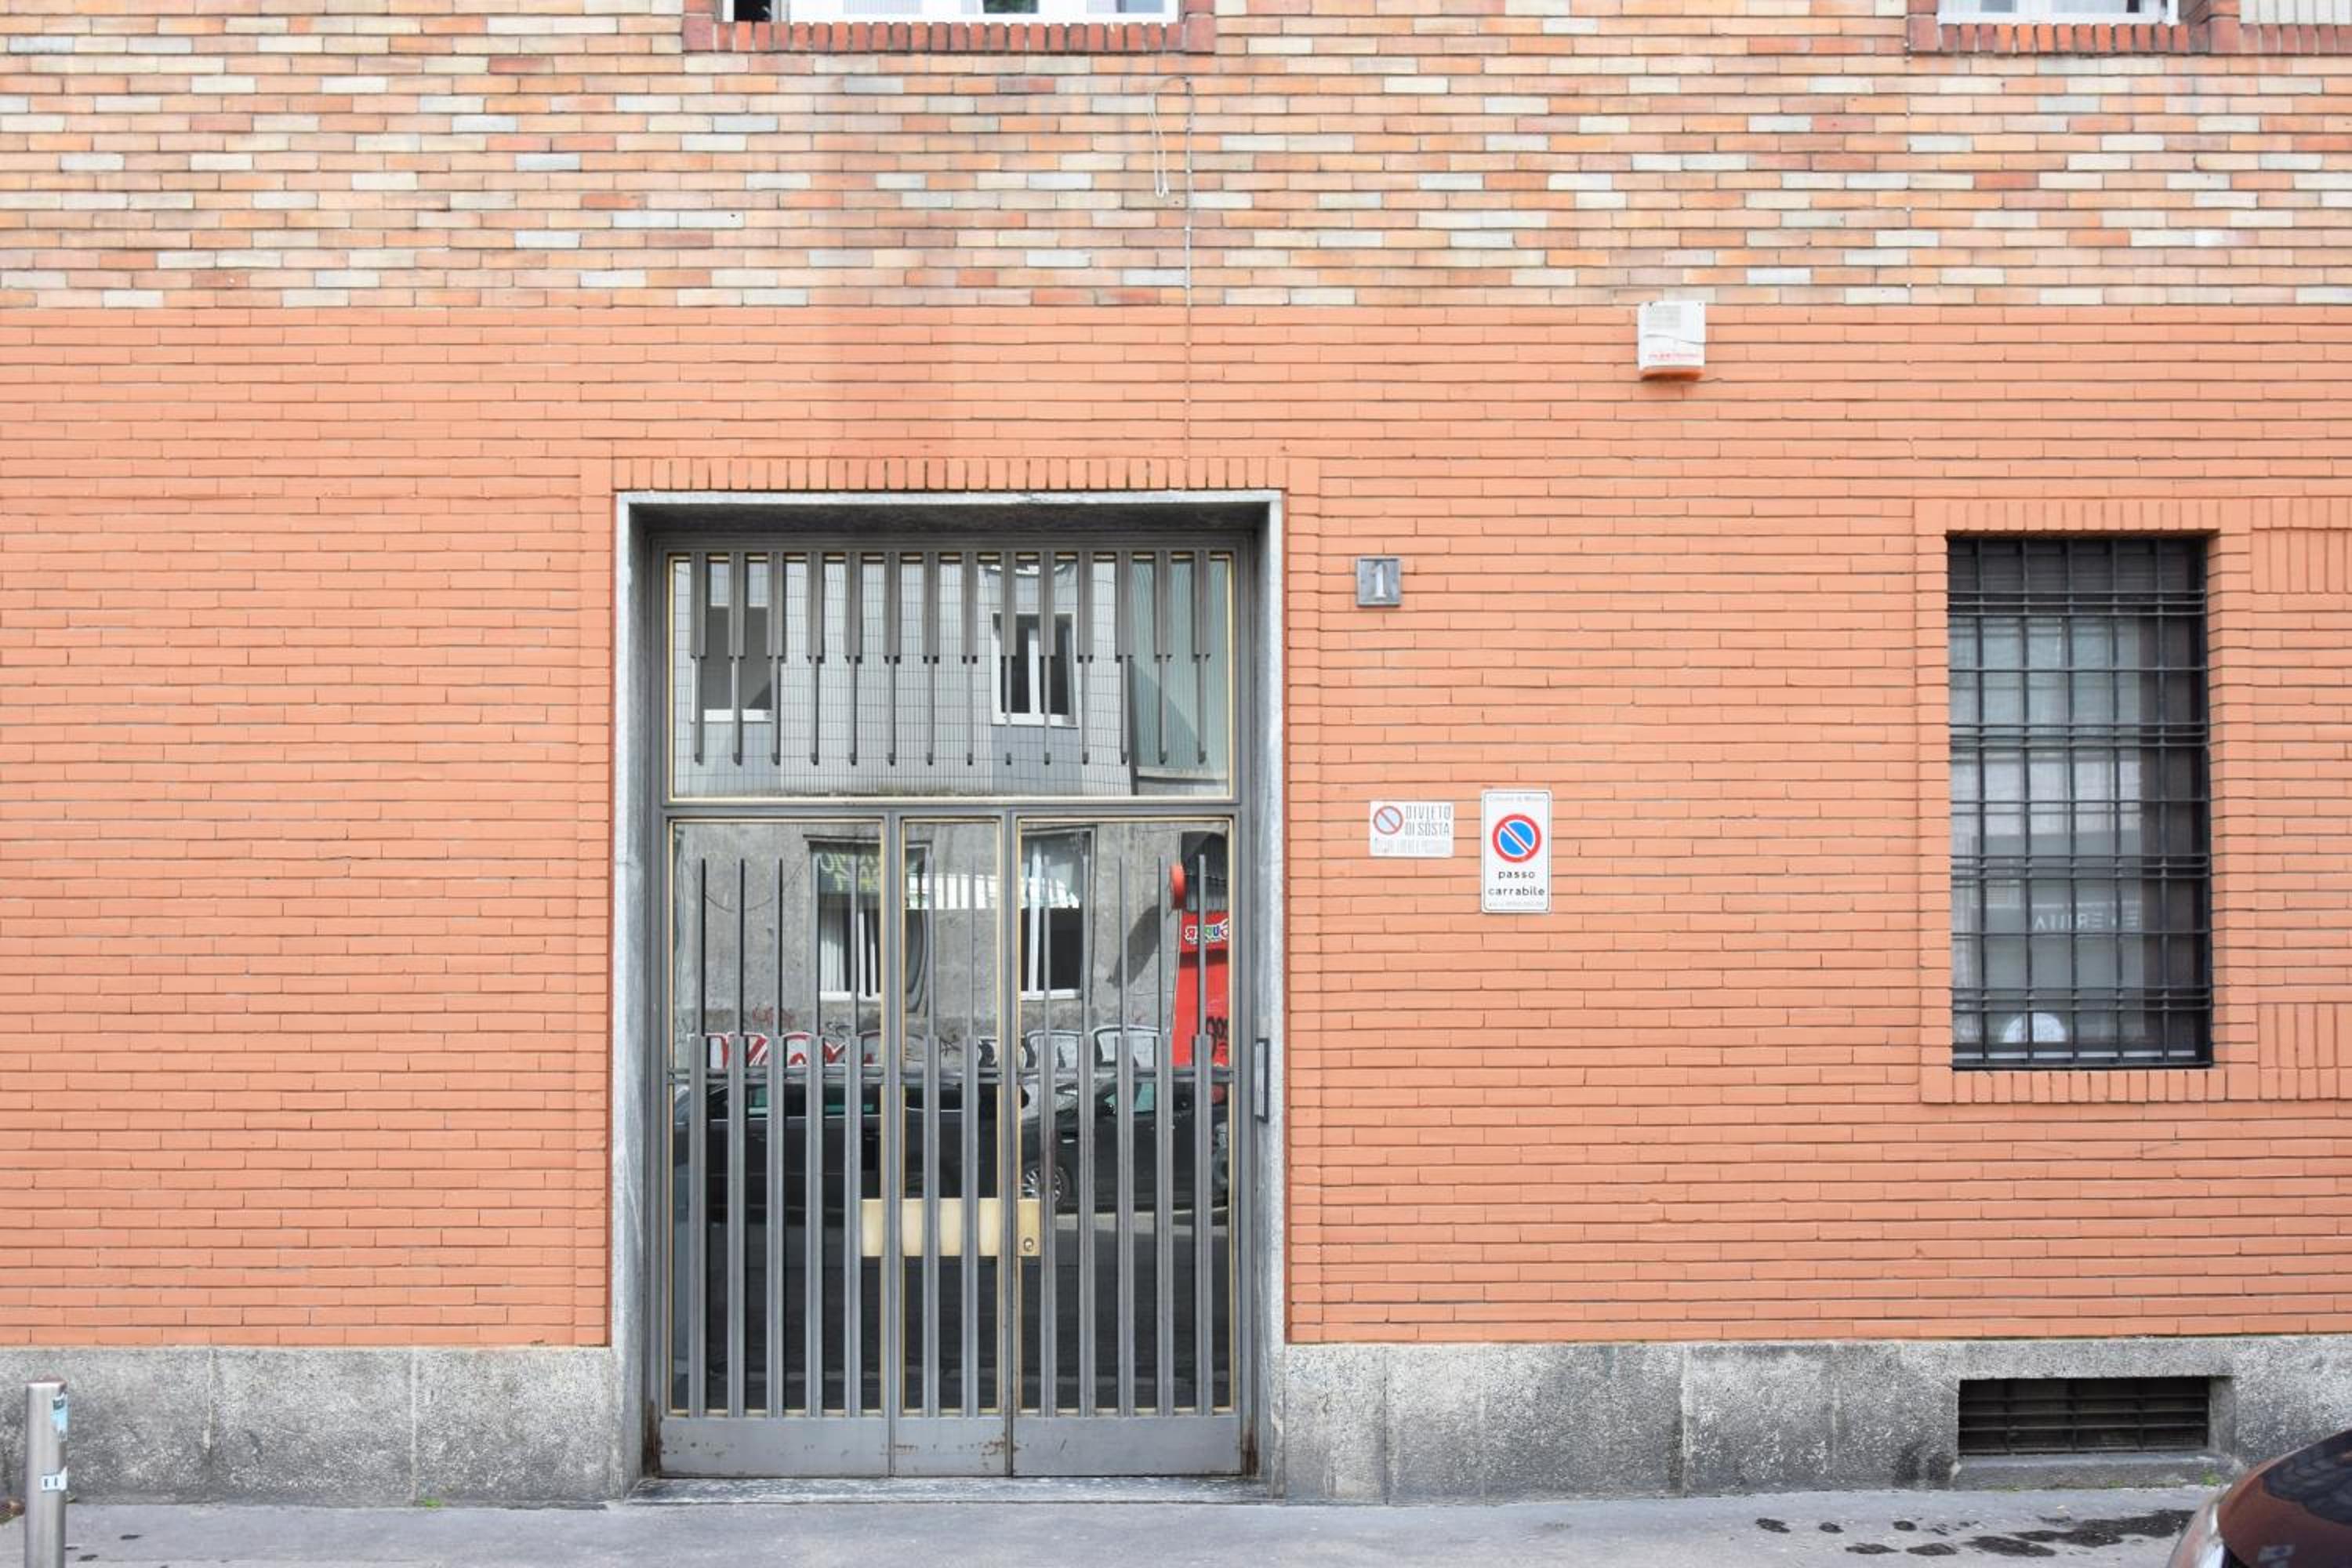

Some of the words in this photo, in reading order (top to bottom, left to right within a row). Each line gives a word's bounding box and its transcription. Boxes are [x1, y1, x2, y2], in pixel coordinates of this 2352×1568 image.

[1370, 564, 1387, 598] 1
[1405, 805, 1451, 819] DIVIETO
[1405, 822, 1414, 836] DI
[1417, 822, 1450, 836] SOSTA
[1498, 870, 1535, 880] passo
[1488, 885, 1545, 896] carrabile
